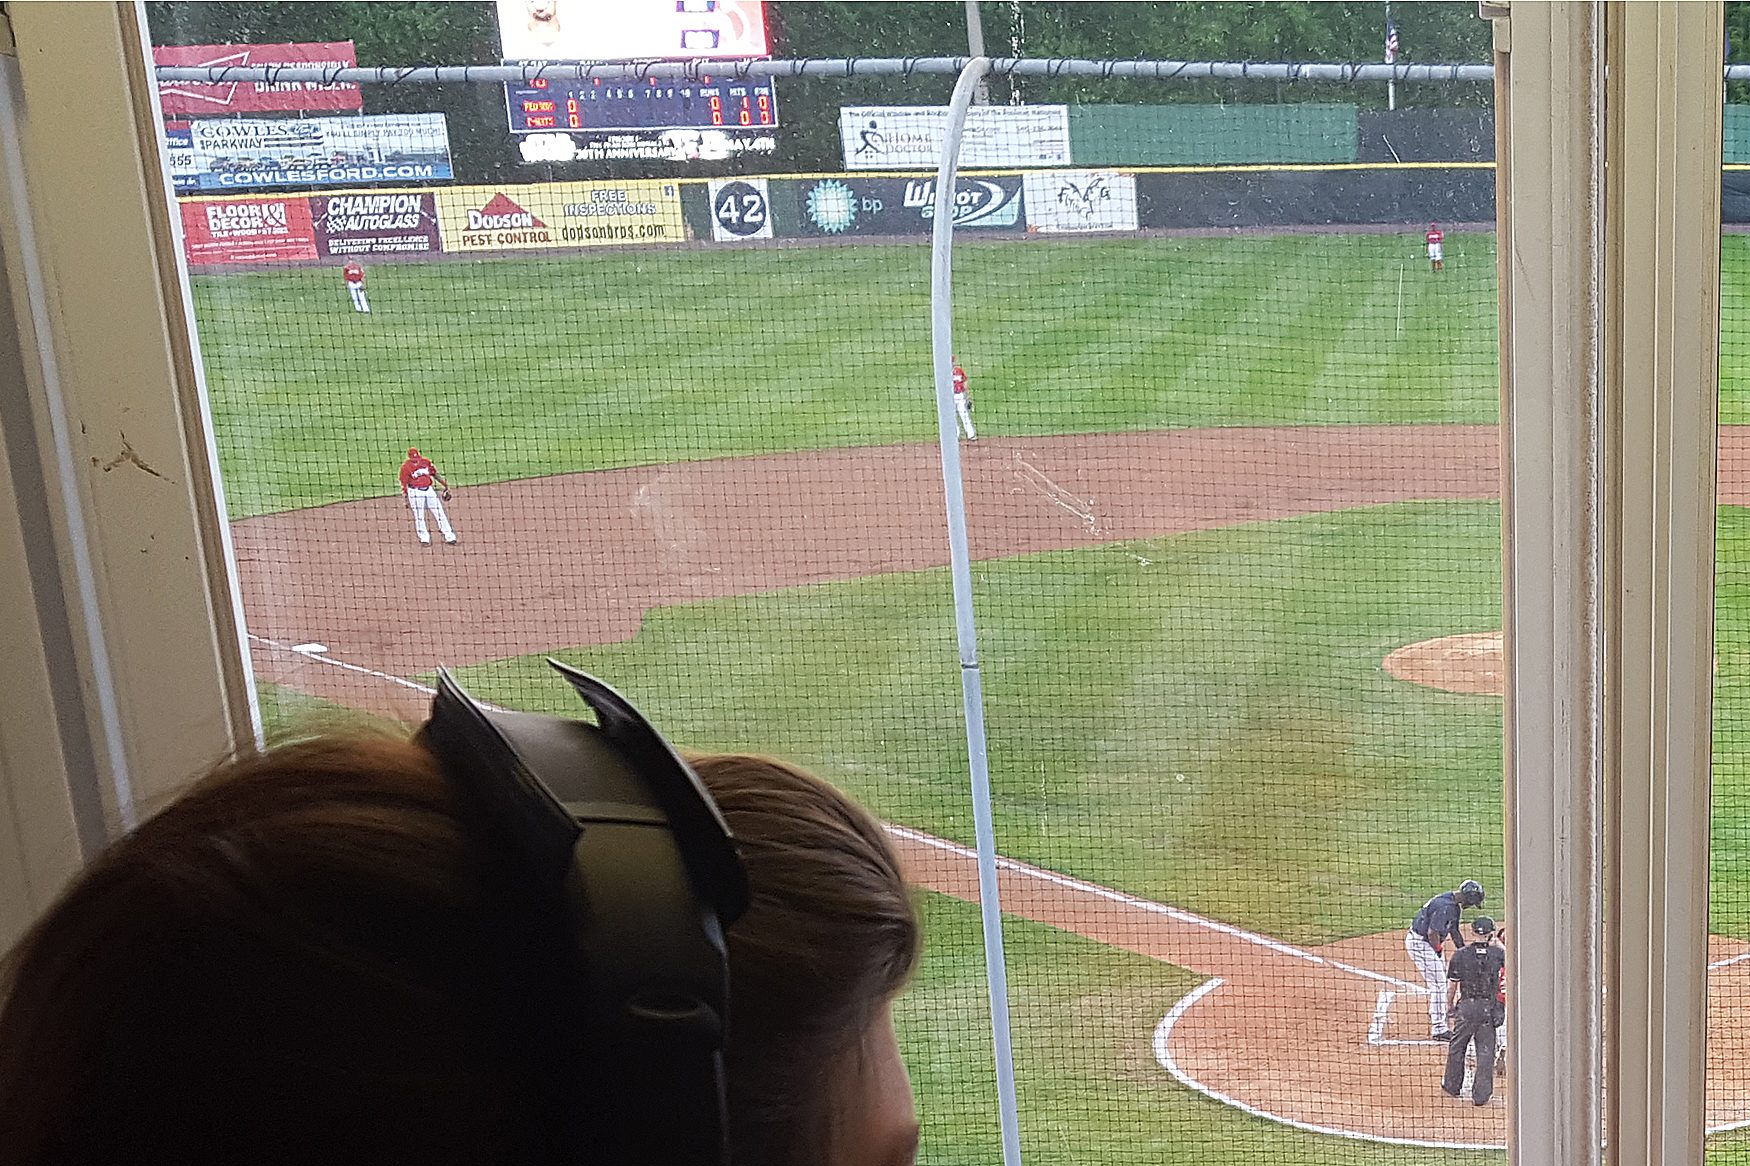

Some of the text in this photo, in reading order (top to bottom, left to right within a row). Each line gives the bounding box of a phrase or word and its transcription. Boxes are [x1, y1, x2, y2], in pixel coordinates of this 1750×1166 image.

[200, 125, 289, 139] COWLES
[204, 139, 262, 150] PARKWAY
[220, 166, 433, 185] COWLESFORD.COM
[327, 195, 421, 215] CHAMPION
[591, 190, 627, 203] FREE
[206, 205, 262, 219] FLOOR
[563, 202, 656, 217] INSPECTIONS
[718, 194, 763, 224] 42
[862, 196, 883, 215] bp
[209, 217, 263, 231] DECOR
[346, 214, 420, 231] AUTOGLASS
[467, 209, 532, 230] DODSON
[462, 230, 552, 247] PEST CONTROL
[561, 222, 665, 241] dodsonbros.com
[329, 245, 372, 255] WITHOUT
